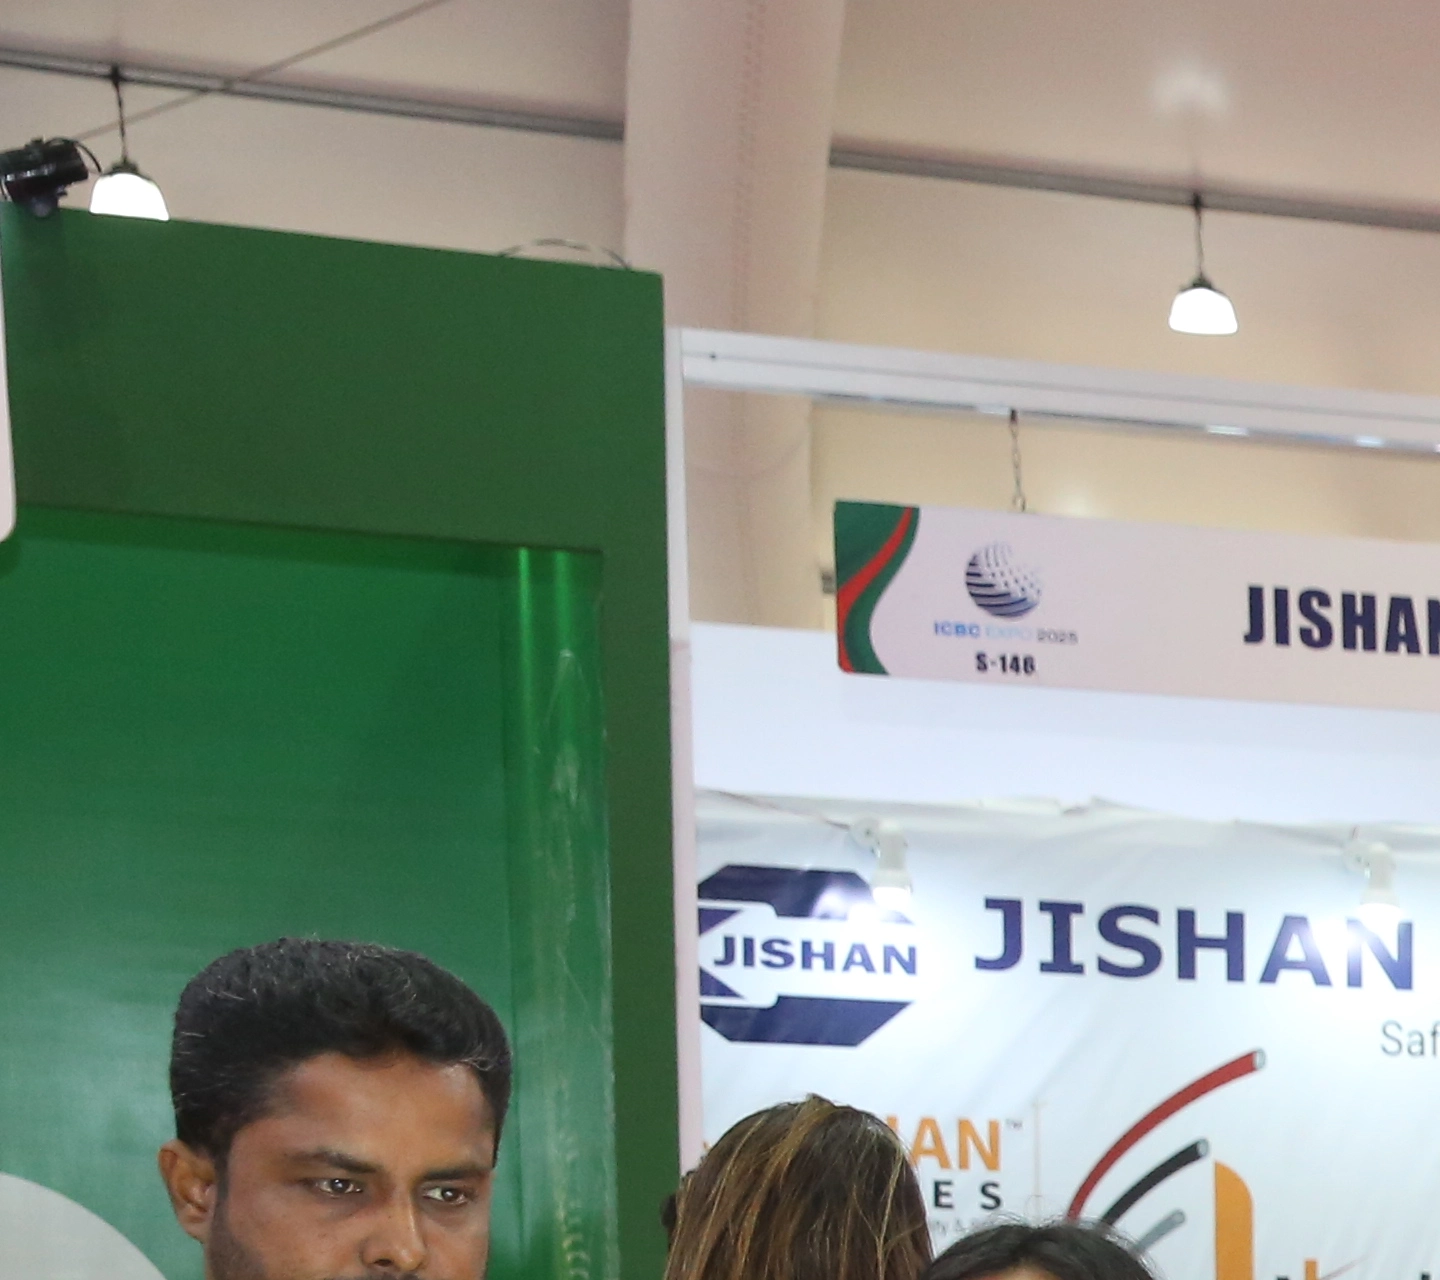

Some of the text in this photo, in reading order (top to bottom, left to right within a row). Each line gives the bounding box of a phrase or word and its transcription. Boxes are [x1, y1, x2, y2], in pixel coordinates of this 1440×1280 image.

[934, 620, 981, 638] ICBC
[714, 935, 919, 976] JISHAN
[975, 896, 1415, 992] JISHAN
